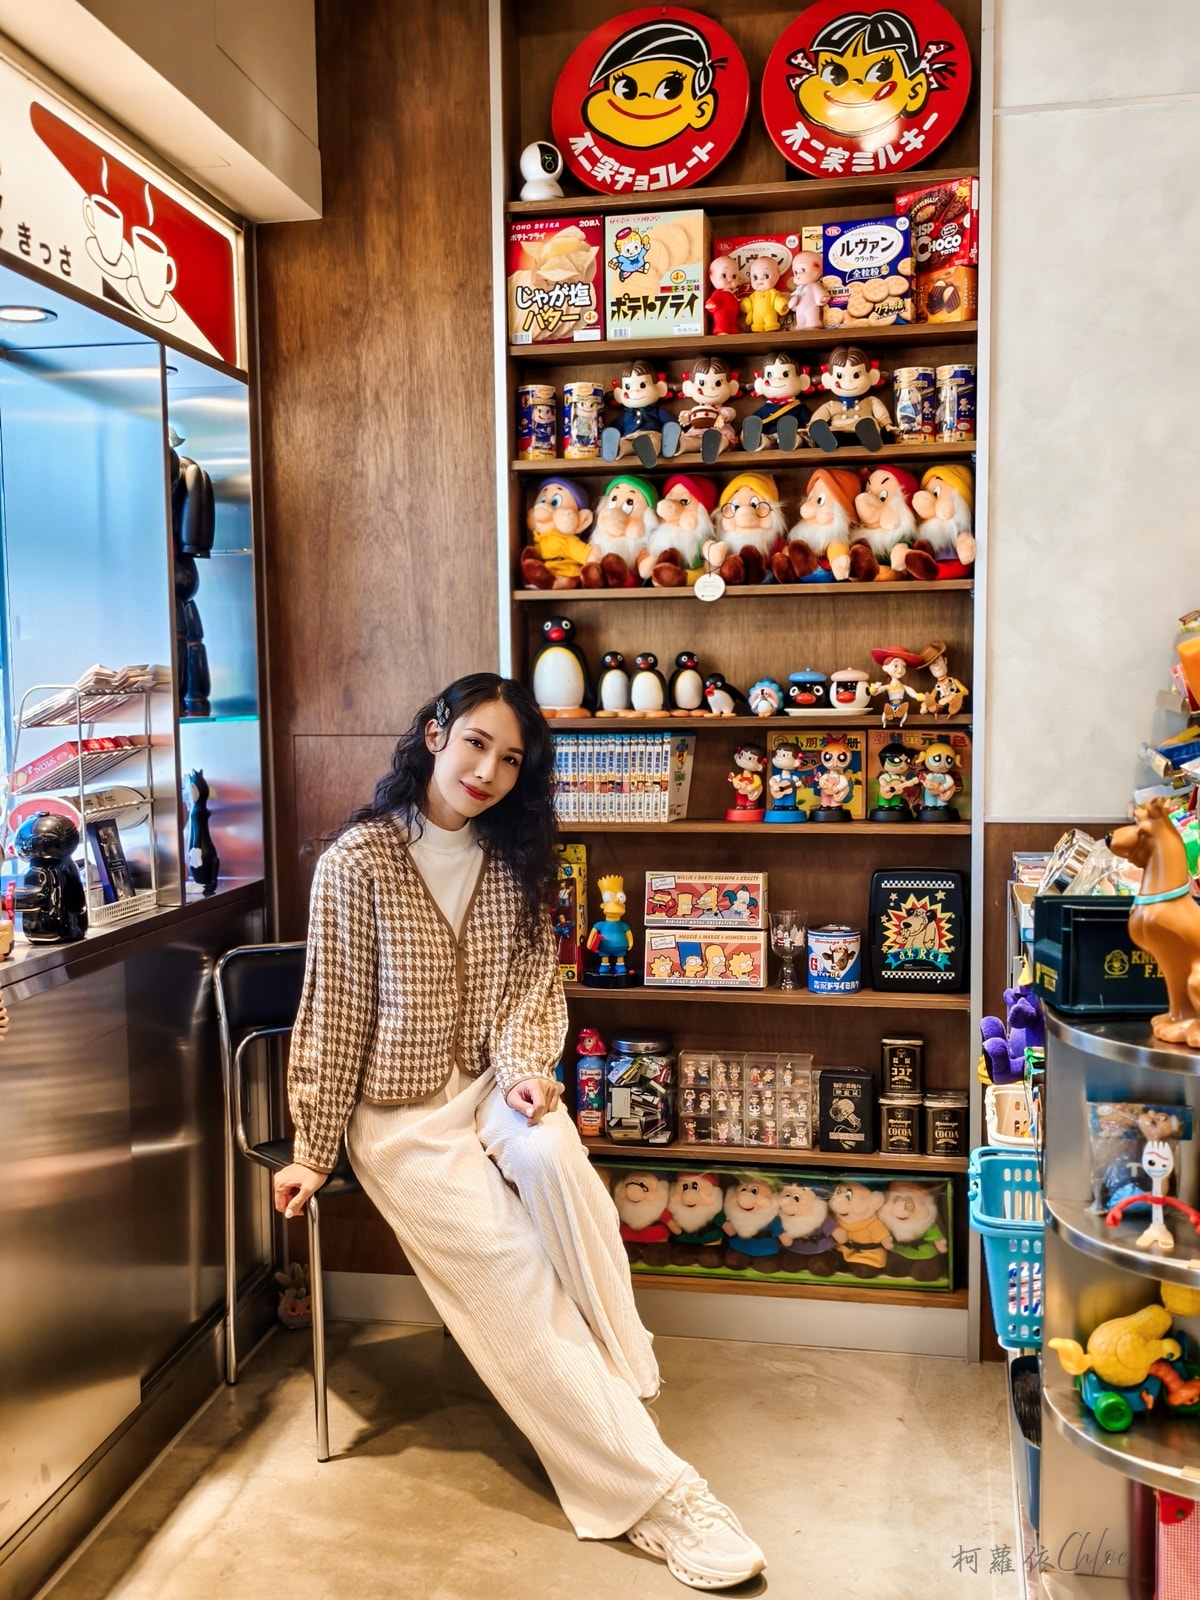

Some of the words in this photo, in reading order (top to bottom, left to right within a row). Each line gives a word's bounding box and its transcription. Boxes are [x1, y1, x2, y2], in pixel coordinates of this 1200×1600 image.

[781, 112, 940, 174] 不二家ミルキー
[568, 131, 716, 192] 不二家チョコレート
[839, 236, 895, 258] ルヴァン
[916, 234, 962, 262] CHOCO
[852, 268, 880, 278] 全粒粉
[515, 282, 592, 310] じゃが塩
[610, 292, 700, 323] ポテトフライ
[522, 307, 582, 332] バター
[33, 757, 57, 774] SPECIAL
[891, 1067, 912, 1076] ココア
[888, 1128, 912, 1137] COCOA
[935, 1130, 959, 1139] COCOA
